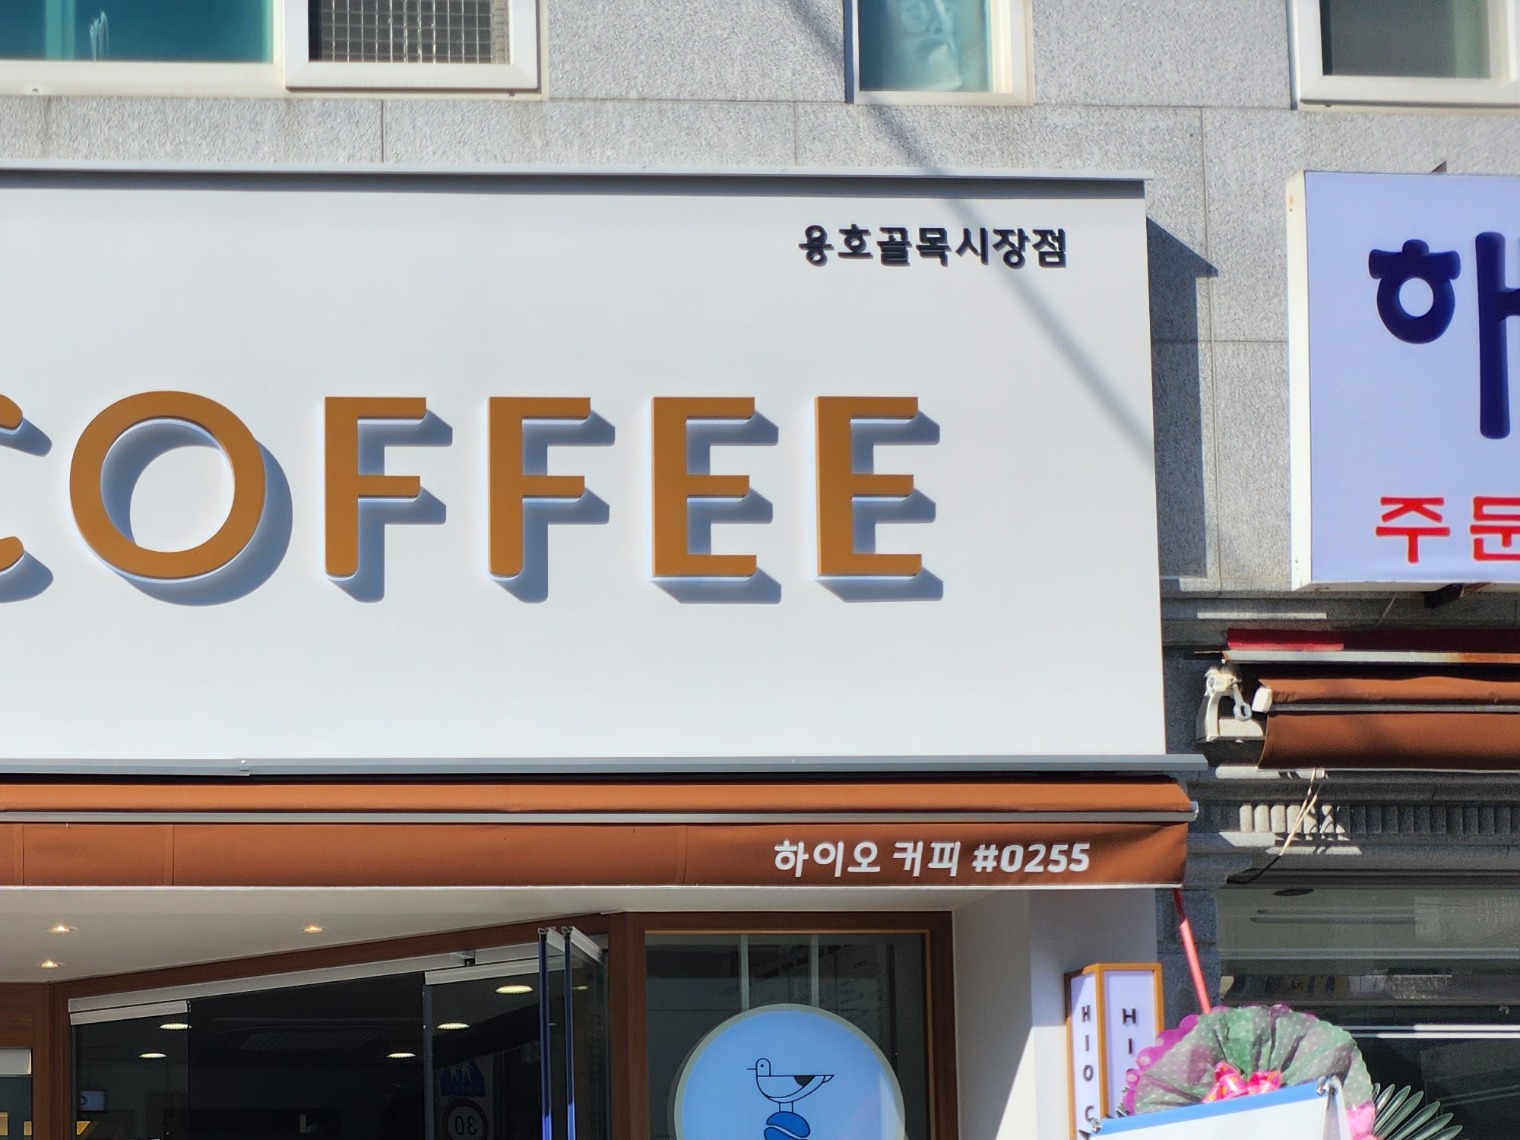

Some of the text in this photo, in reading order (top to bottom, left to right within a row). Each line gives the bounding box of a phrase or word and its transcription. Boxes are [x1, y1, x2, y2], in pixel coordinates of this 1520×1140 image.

[799, 223, 1068, 269] 용호골목시장점
[775, 839, 1091, 878] 하이오 커피 #0255
